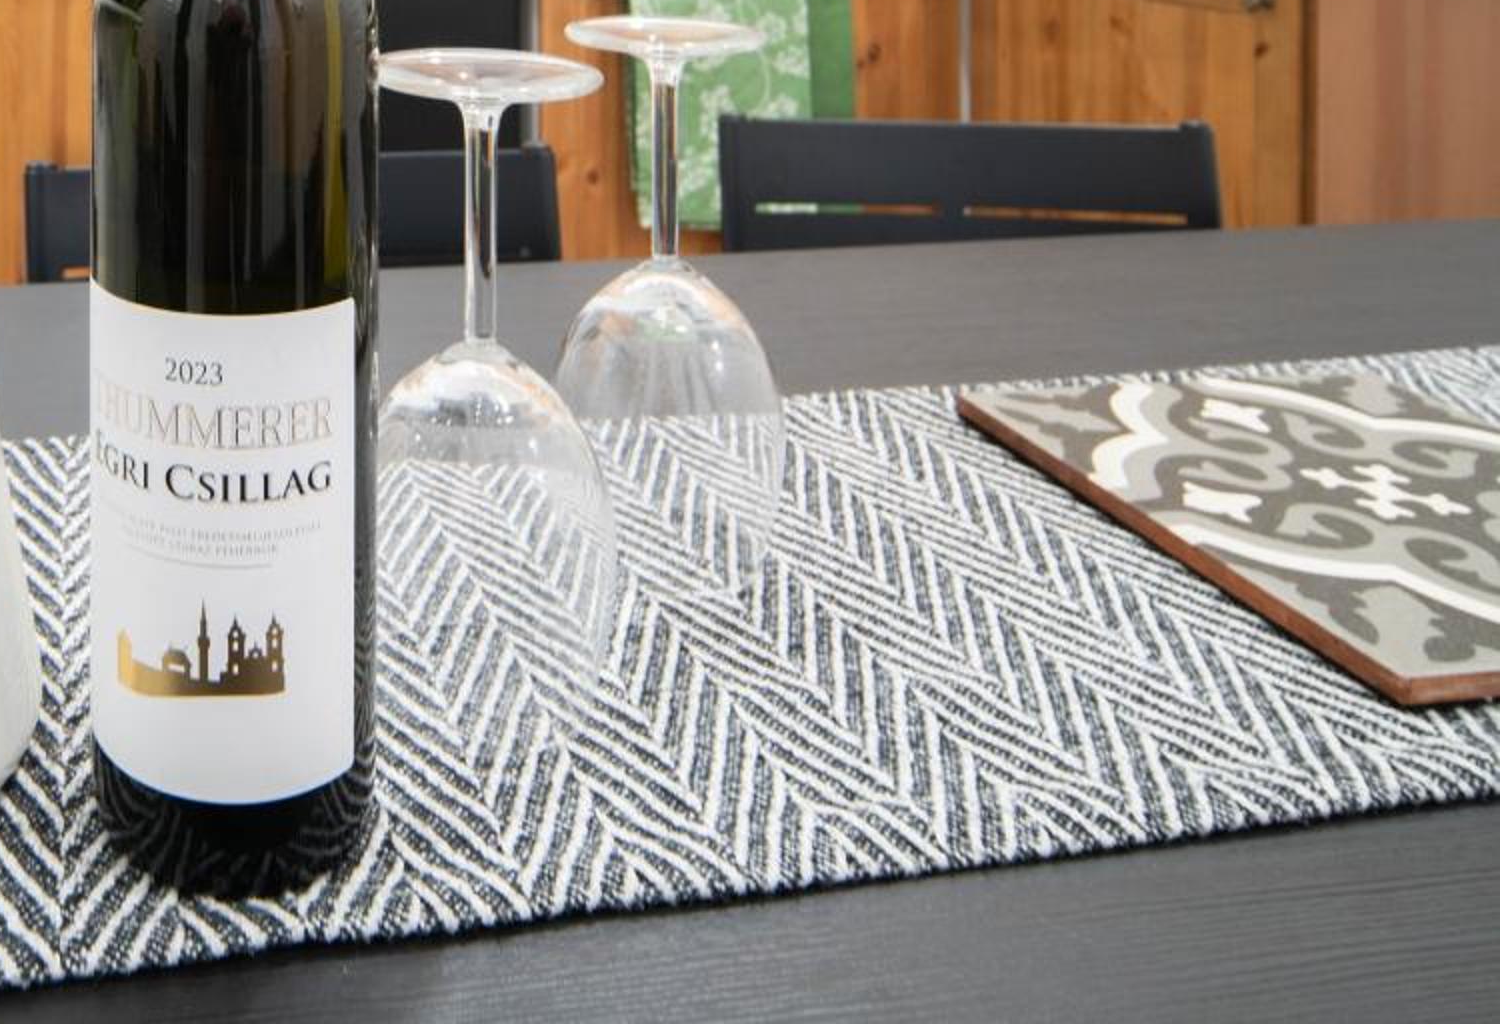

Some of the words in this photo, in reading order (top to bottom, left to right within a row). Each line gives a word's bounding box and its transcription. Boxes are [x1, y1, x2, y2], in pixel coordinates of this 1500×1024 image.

[164, 356, 224, 386] 2023
[95, 428, 150, 491] EGRI
[164, 461, 333, 504] CSILLAG
